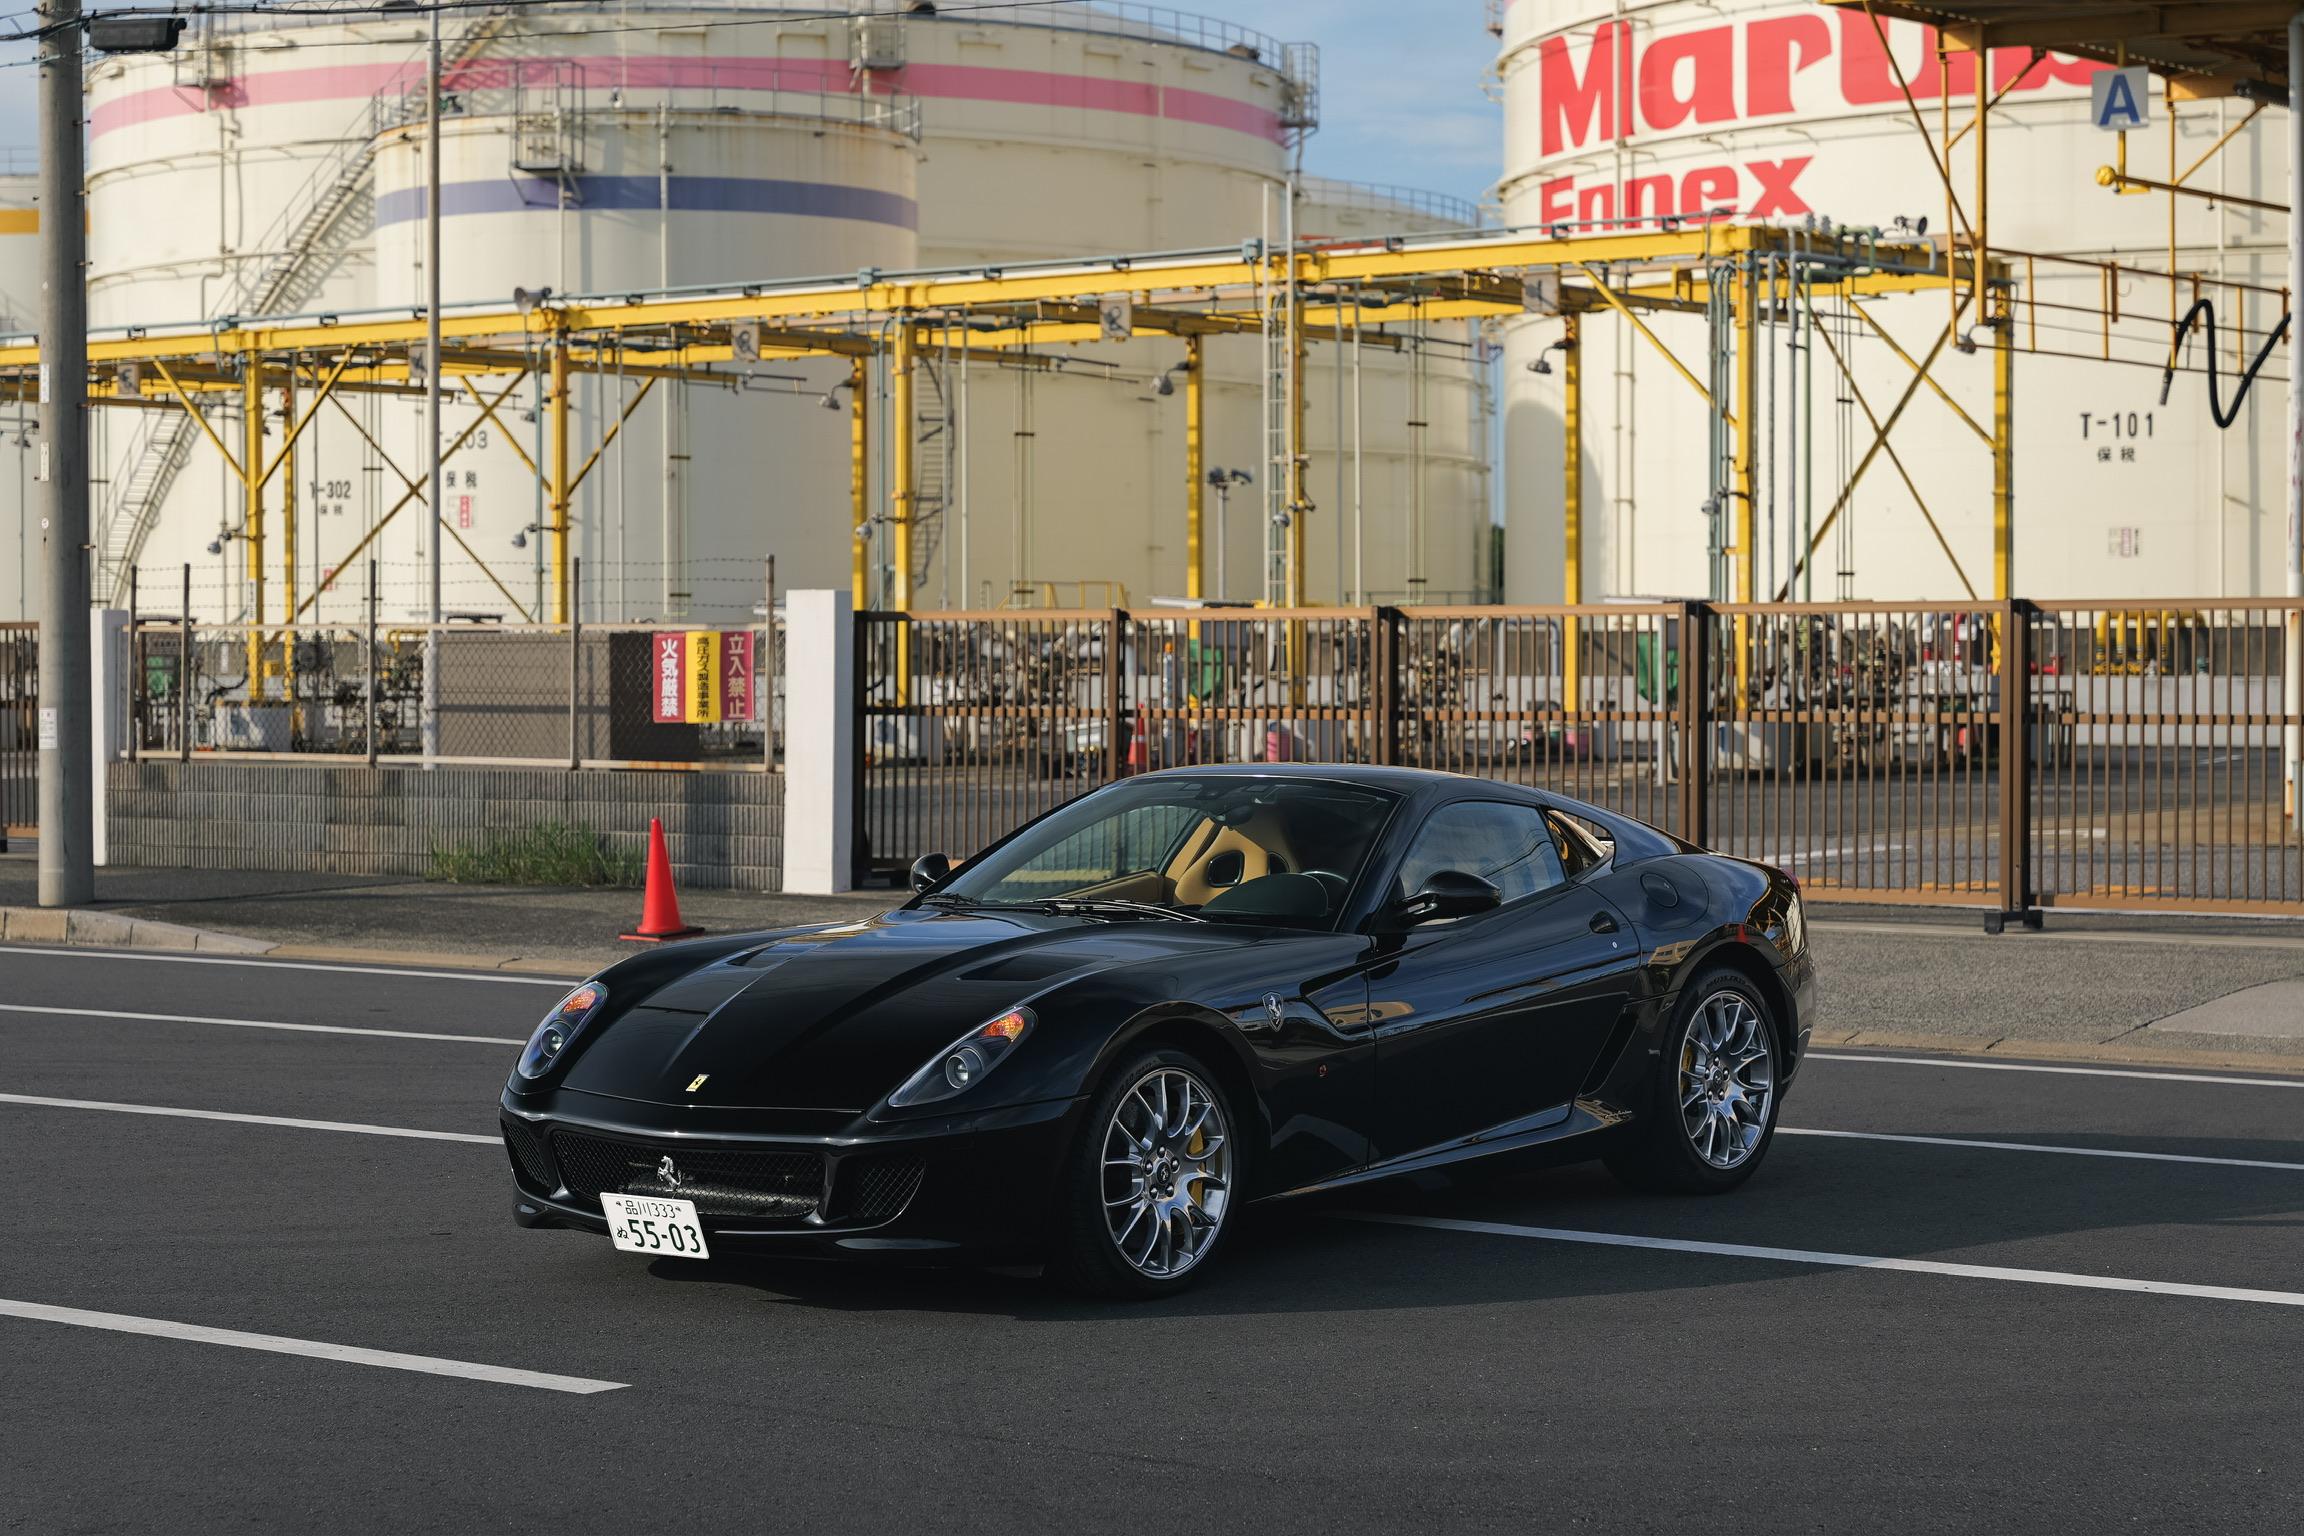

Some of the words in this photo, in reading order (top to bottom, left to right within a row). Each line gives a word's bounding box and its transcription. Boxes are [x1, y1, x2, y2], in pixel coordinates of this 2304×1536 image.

[1540, 8, 2118, 157] Maru
[2099, 74, 2140, 126] A
[1540, 156, 1814, 235] Ennex
[2080, 412, 2153, 439] T-101
[2097, 447, 2136, 462] 保税
[661, 638, 678, 717] 火気厳禁
[696, 636, 710, 718] 高圧ガス製造事業所
[728, 634, 745, 719] 立入禁止
[628, 1219, 701, 1253] 55-03
